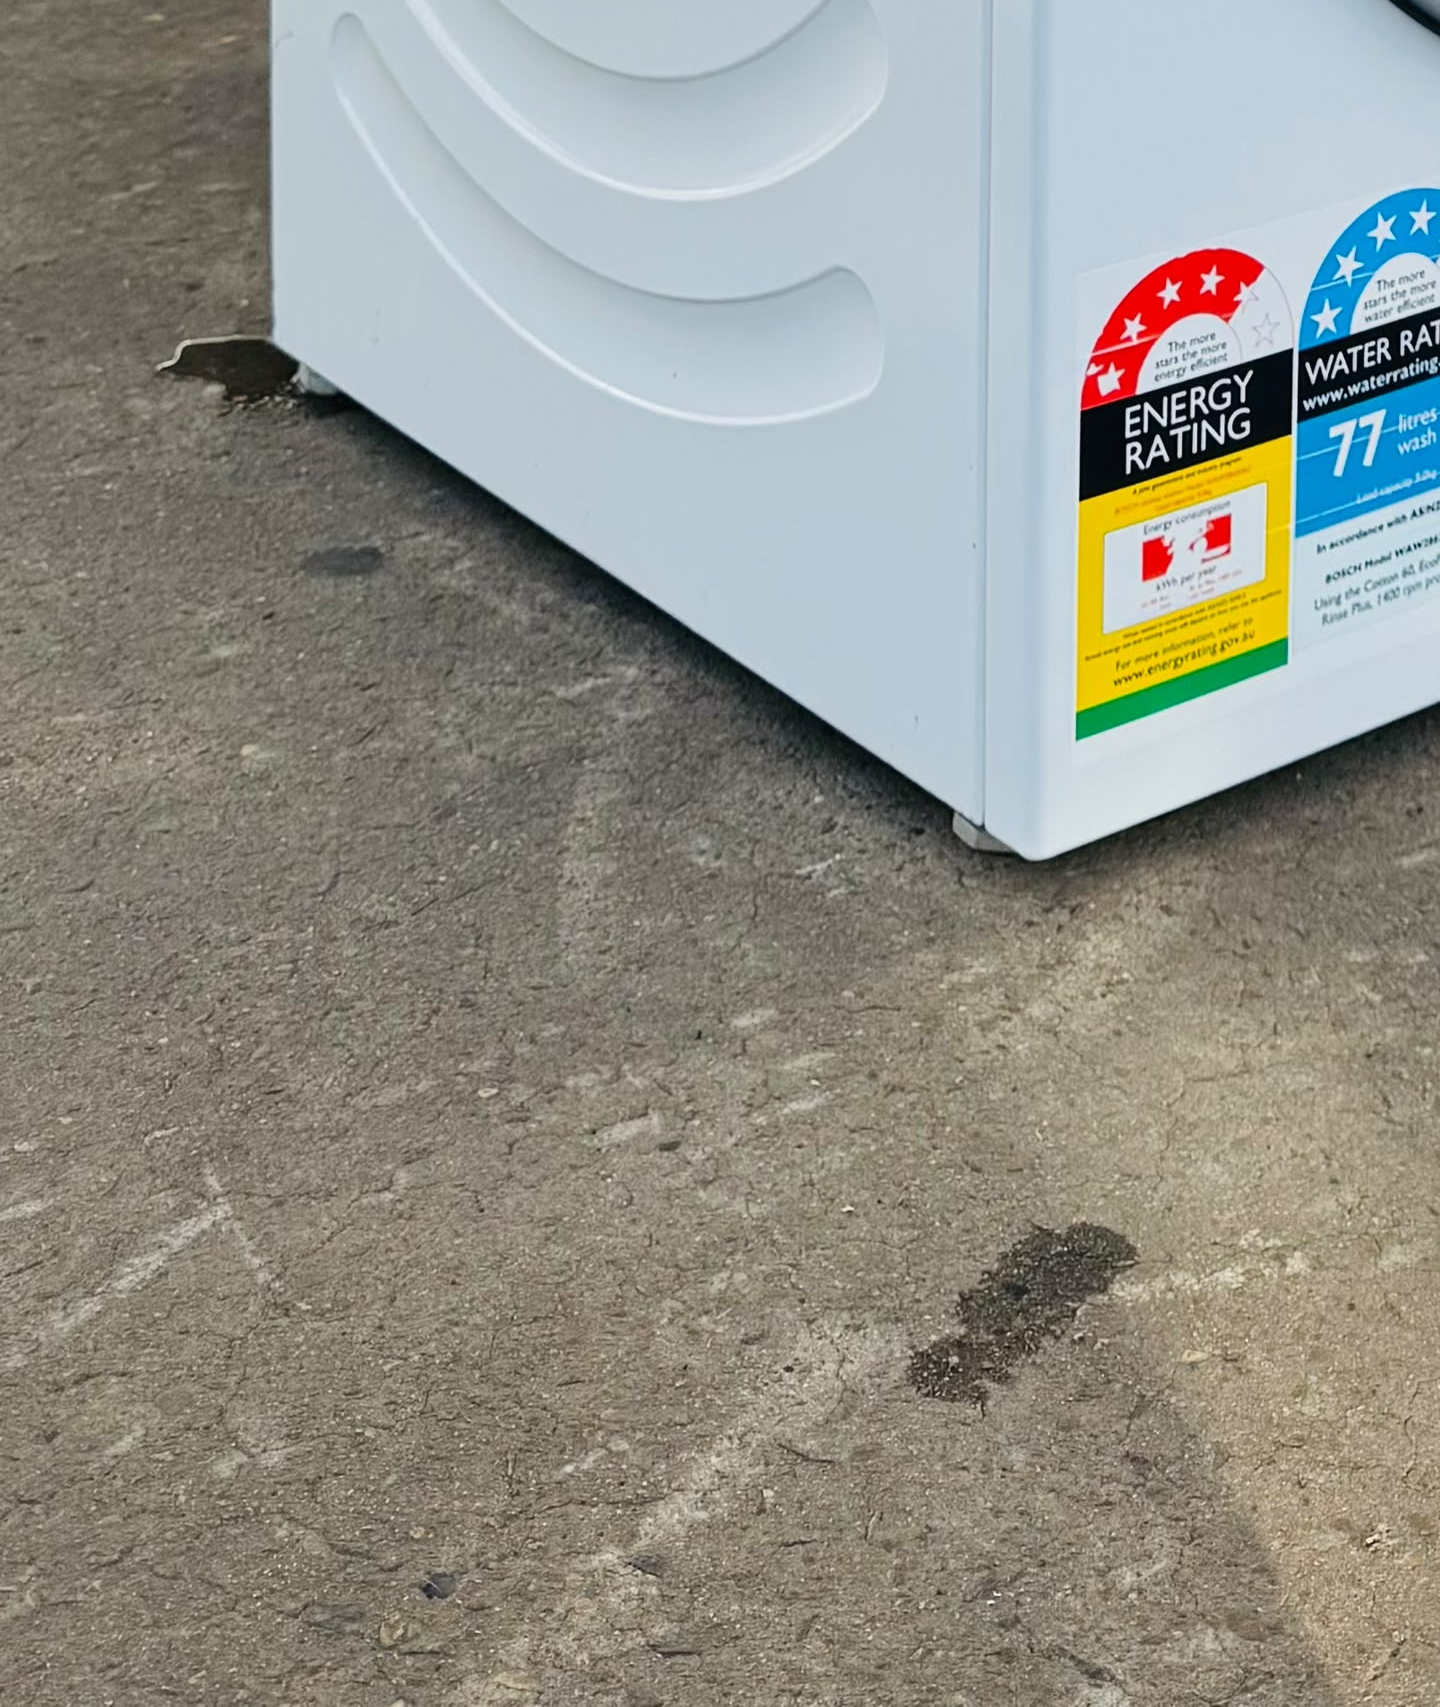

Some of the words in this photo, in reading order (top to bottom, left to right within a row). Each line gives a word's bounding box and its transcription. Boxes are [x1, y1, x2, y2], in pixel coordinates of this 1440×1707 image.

[1363, 295, 1388, 311] stars
[1390, 287, 1407, 301] the
[1410, 279, 1437, 295] more
[1377, 279, 1395, 293] The
[1398, 269, 1426, 286] more
[1364, 307, 1394, 323] water
[1396, 293, 1436, 314] efficient
[1155, 356, 1179, 370] stars
[1182, 349, 1198, 362] the
[1201, 341, 1228, 355] more
[1168, 340, 1187, 353] The
[1189, 332, 1216, 347] more
[1154, 366, 1187, 383] energy
[1190, 352, 1229, 372] efficient
[1304, 337, 1392, 385] WATER
[1124, 369, 1254, 439] ENERGY
[1398, 407, 1437, 434] litres
[1125, 407, 1251, 476] RATING
[1329, 409, 1387, 477] 77
[1397, 427, 1437, 455] wash
[1143, 518, 1172, 536] Energy
[1175, 500, 1231, 525] consumption
[1316, 543, 1327, 555] In
[1329, 523, 1384, 549] accordance
[1386, 513, 1407, 528] with
[1179, 571, 1196, 587] per
[1324, 562, 1363, 585] BOSCH
[1364, 550, 1393, 570] Model
[1313, 591, 1342, 611] Using
[1344, 585, 1361, 600] the
[1363, 572, 1399, 593] Cotton
[1321, 607, 1348, 627] Rinse
[1113, 627, 1256, 687] www.energyrating.gov.au
[1114, 658, 1132, 673] For
[1133, 649, 1160, 664] more
